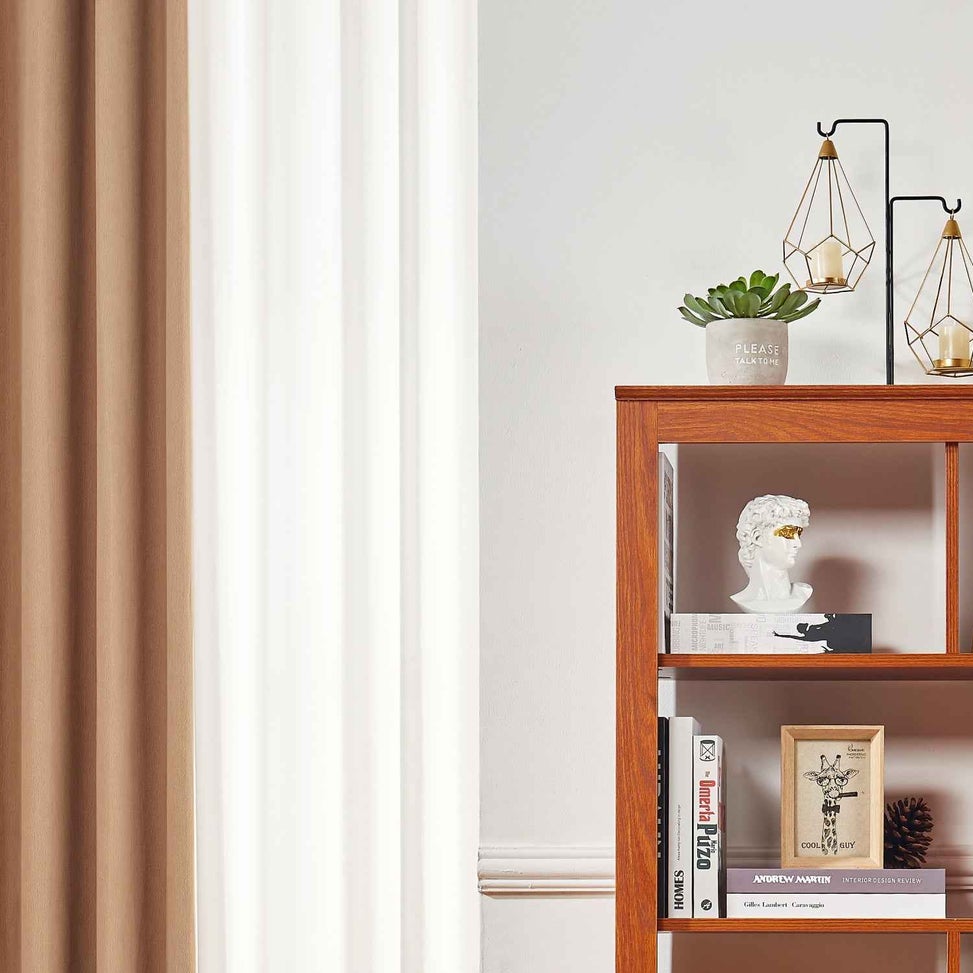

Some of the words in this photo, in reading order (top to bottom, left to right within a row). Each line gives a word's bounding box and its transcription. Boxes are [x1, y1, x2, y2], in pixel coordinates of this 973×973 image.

[735, 344, 779, 356] PLEASE
[735, 357, 756, 365] TALK
[770, 358, 780, 366] ME
[699, 780, 716, 822] Omerta
[697, 823, 718, 870] Puzo
[839, 841, 856, 849] GUY
[753, 874, 794, 884] ANDREW
[795, 875, 831, 885] MARTIN
[674, 870, 685, 910] HOMES
[792, 901, 825, 909] Caravaggio
